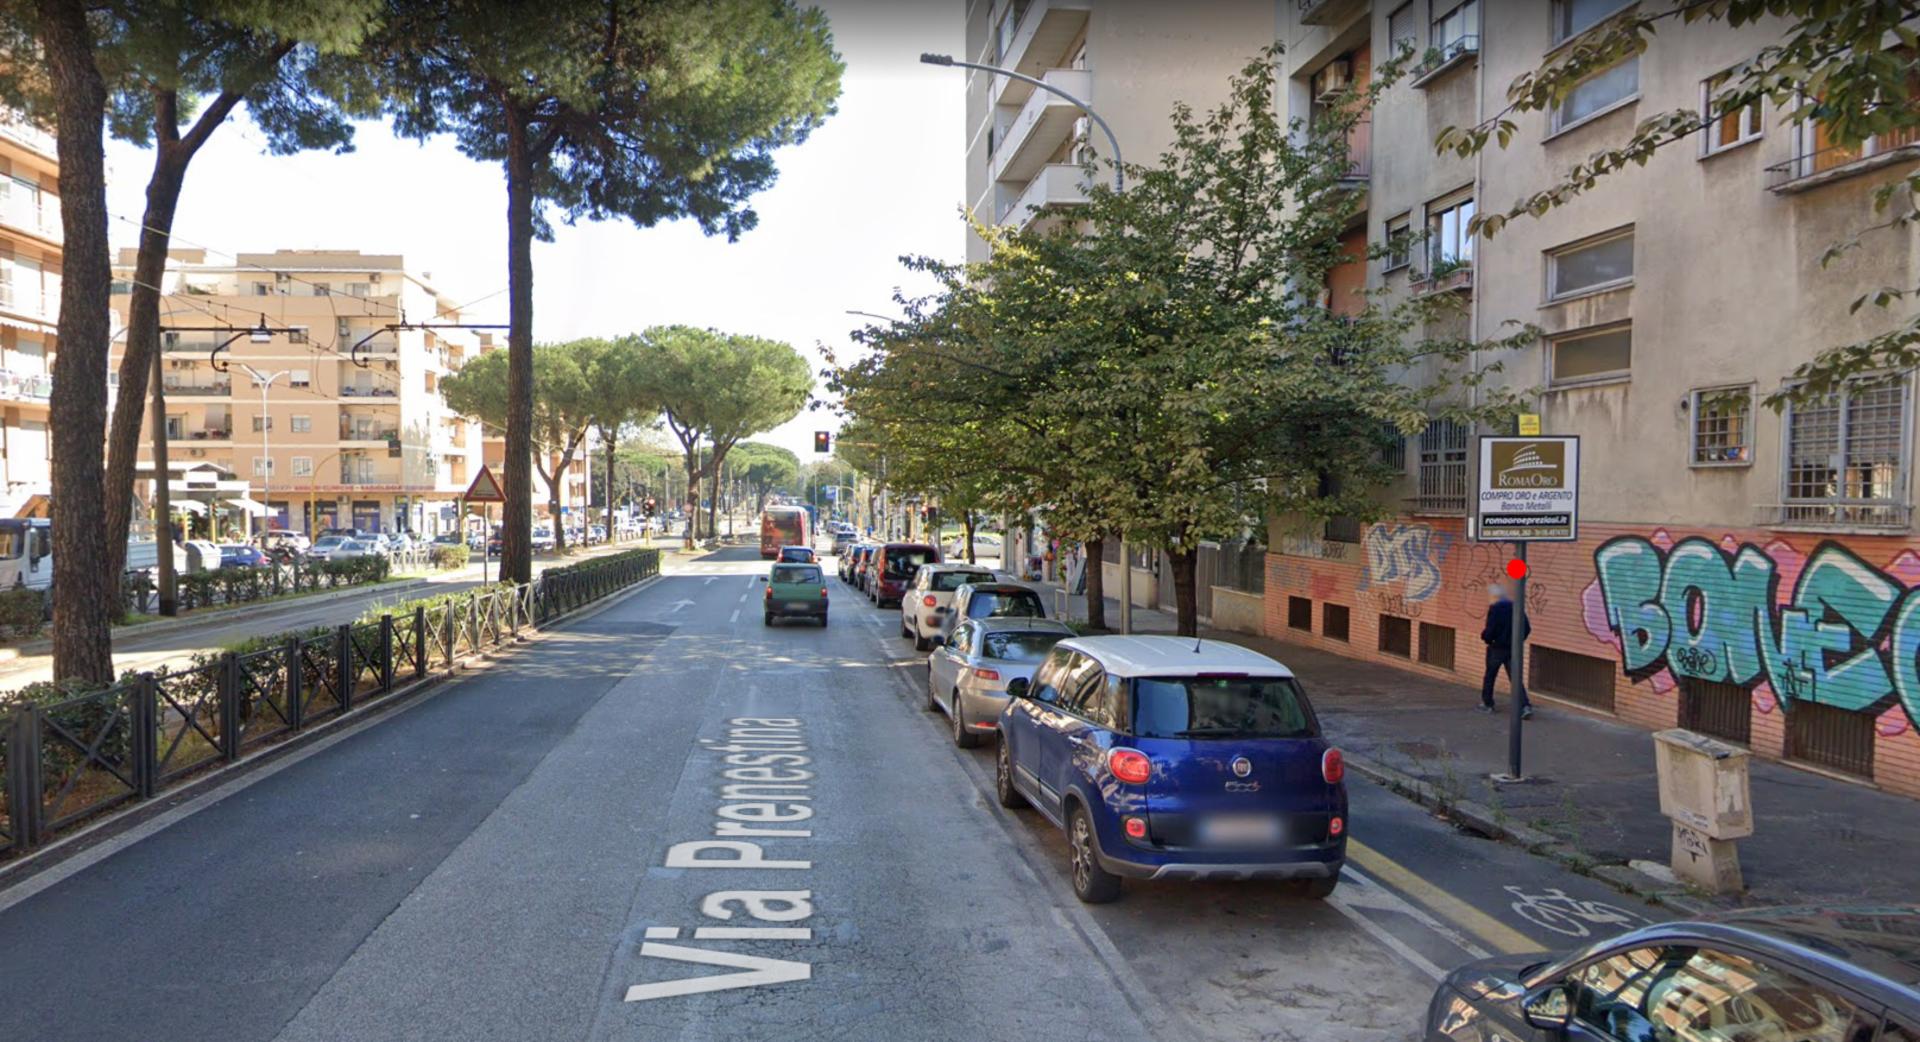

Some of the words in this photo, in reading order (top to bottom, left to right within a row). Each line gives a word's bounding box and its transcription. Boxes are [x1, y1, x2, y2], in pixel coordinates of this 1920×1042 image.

[1481, 491, 1514, 500] COMPRO
[1515, 491, 1531, 500] ORO
[1538, 491, 1573, 500] ARGENTO
